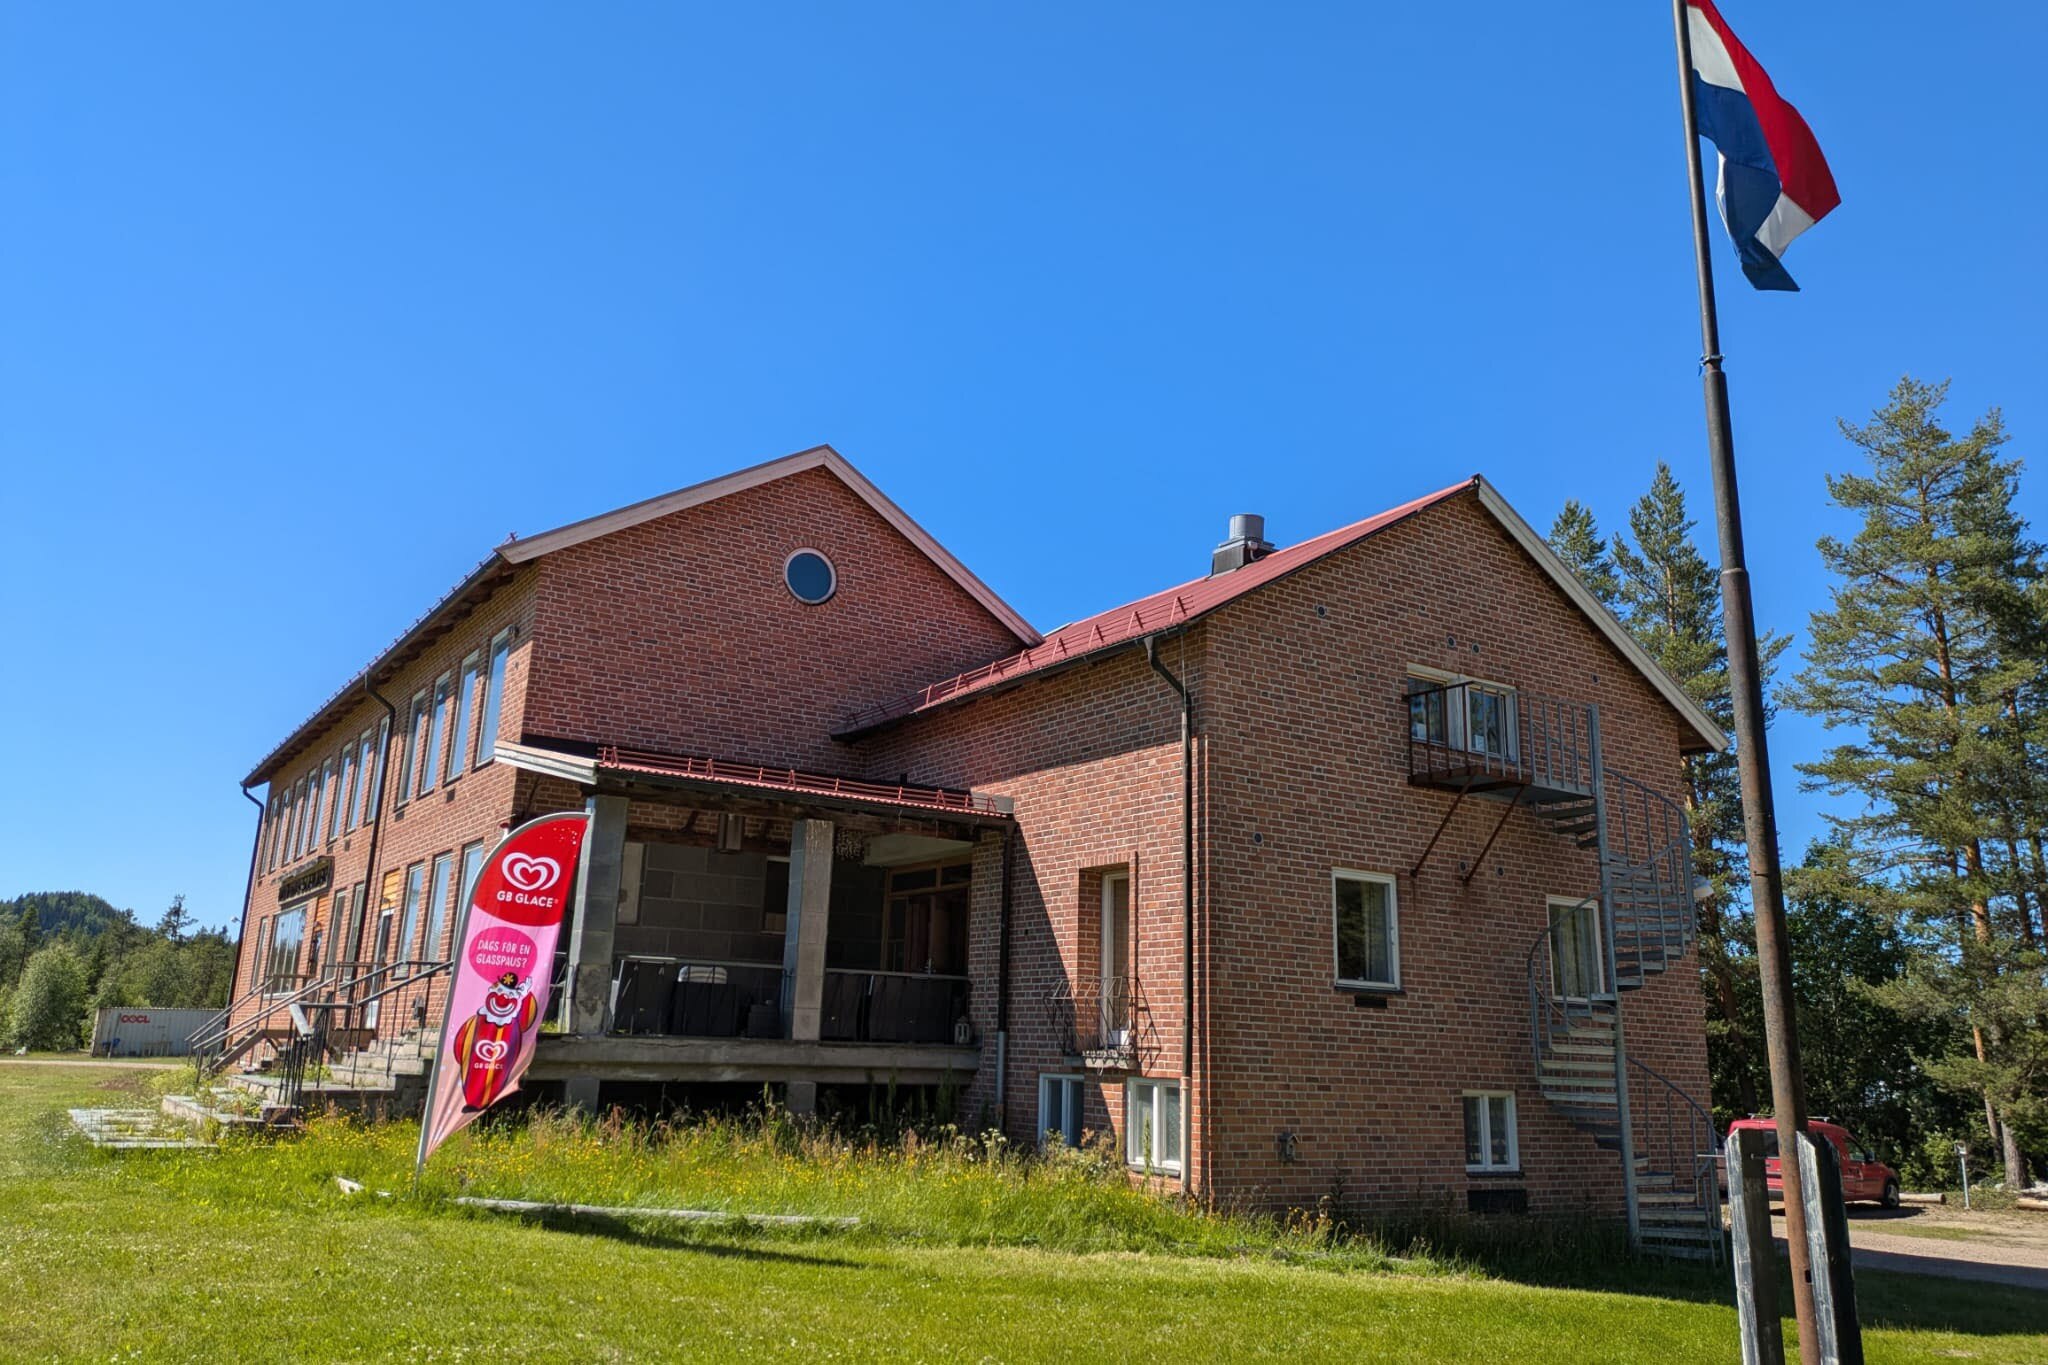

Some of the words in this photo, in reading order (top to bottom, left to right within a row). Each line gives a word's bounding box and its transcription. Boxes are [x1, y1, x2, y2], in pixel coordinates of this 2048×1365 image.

[497, 890, 513, 902] GB
[515, 893, 553, 907] GLACE
[478, 940, 499, 951] DAGS
[519, 944, 530, 955] EN
[476, 953, 527, 968] GLASSPAUS?
